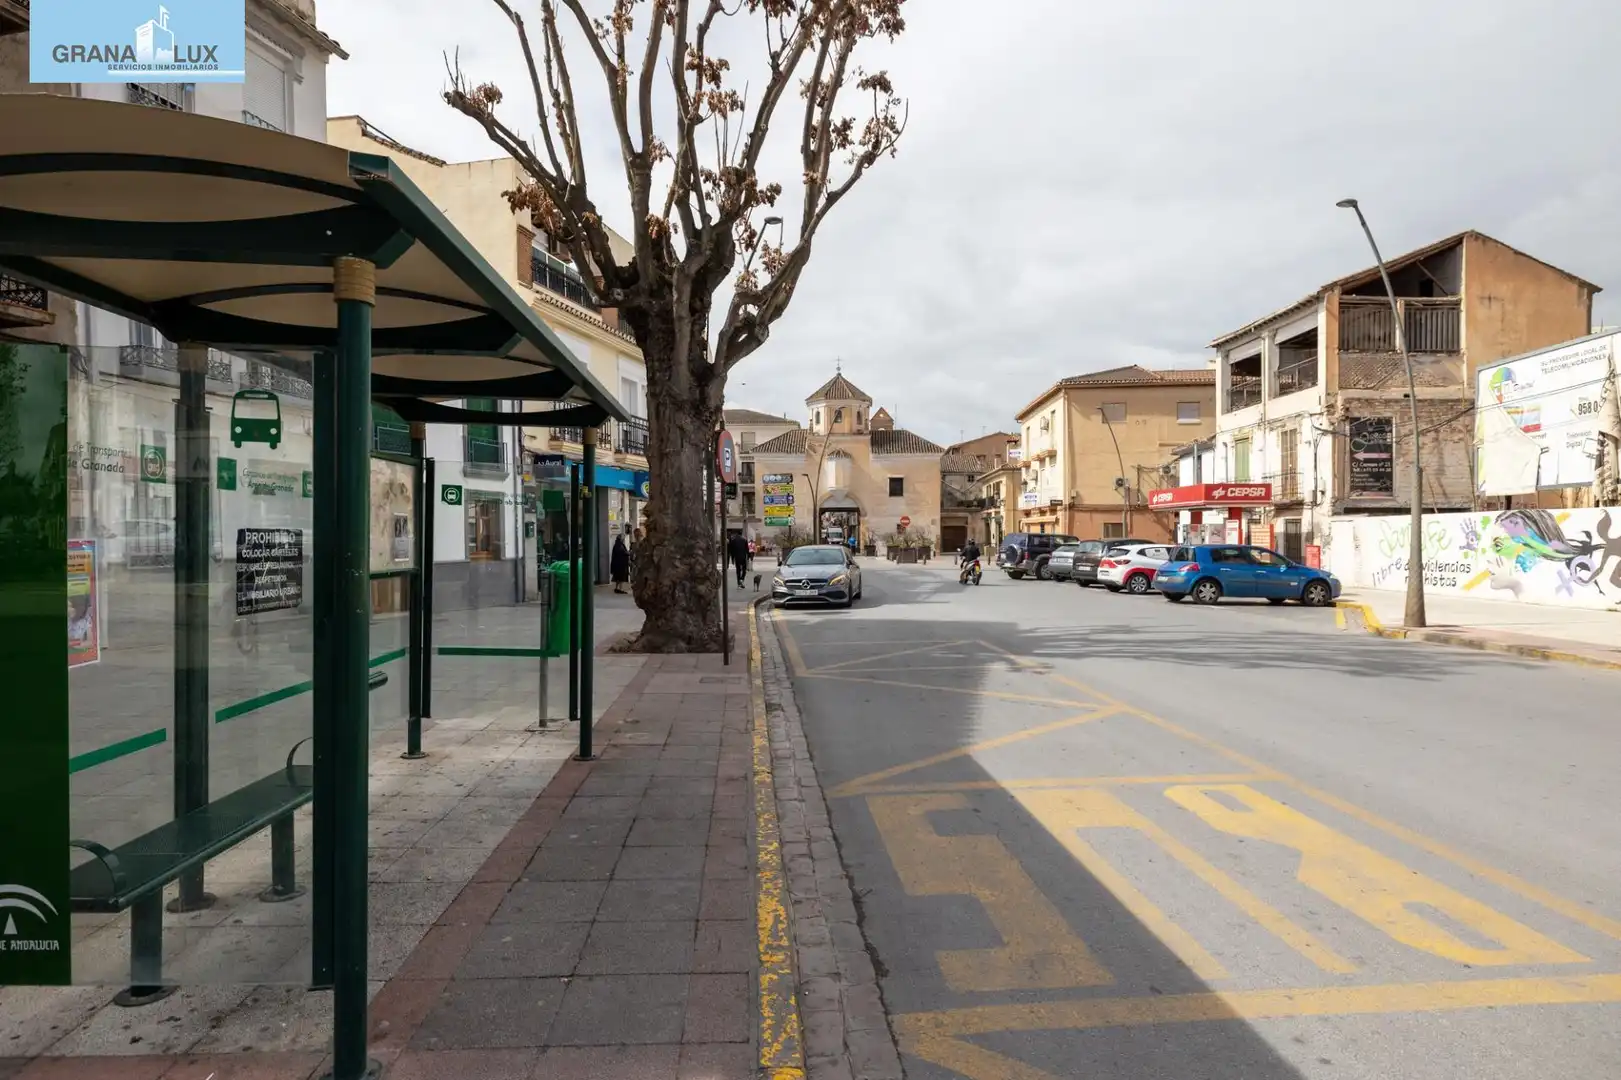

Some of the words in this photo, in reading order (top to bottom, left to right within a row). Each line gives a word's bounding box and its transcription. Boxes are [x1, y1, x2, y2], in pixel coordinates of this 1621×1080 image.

[1578, 402, 1592, 415] 958
[81, 458, 125, 473] Granada
[1227, 487, 1266, 497] CEPSA
[241, 548, 270, 558] COLOCAR
[1372, 557, 1403, 588] libre
[1421, 560, 1471, 573] violencias
[864, 782, 1594, 993] BUS
